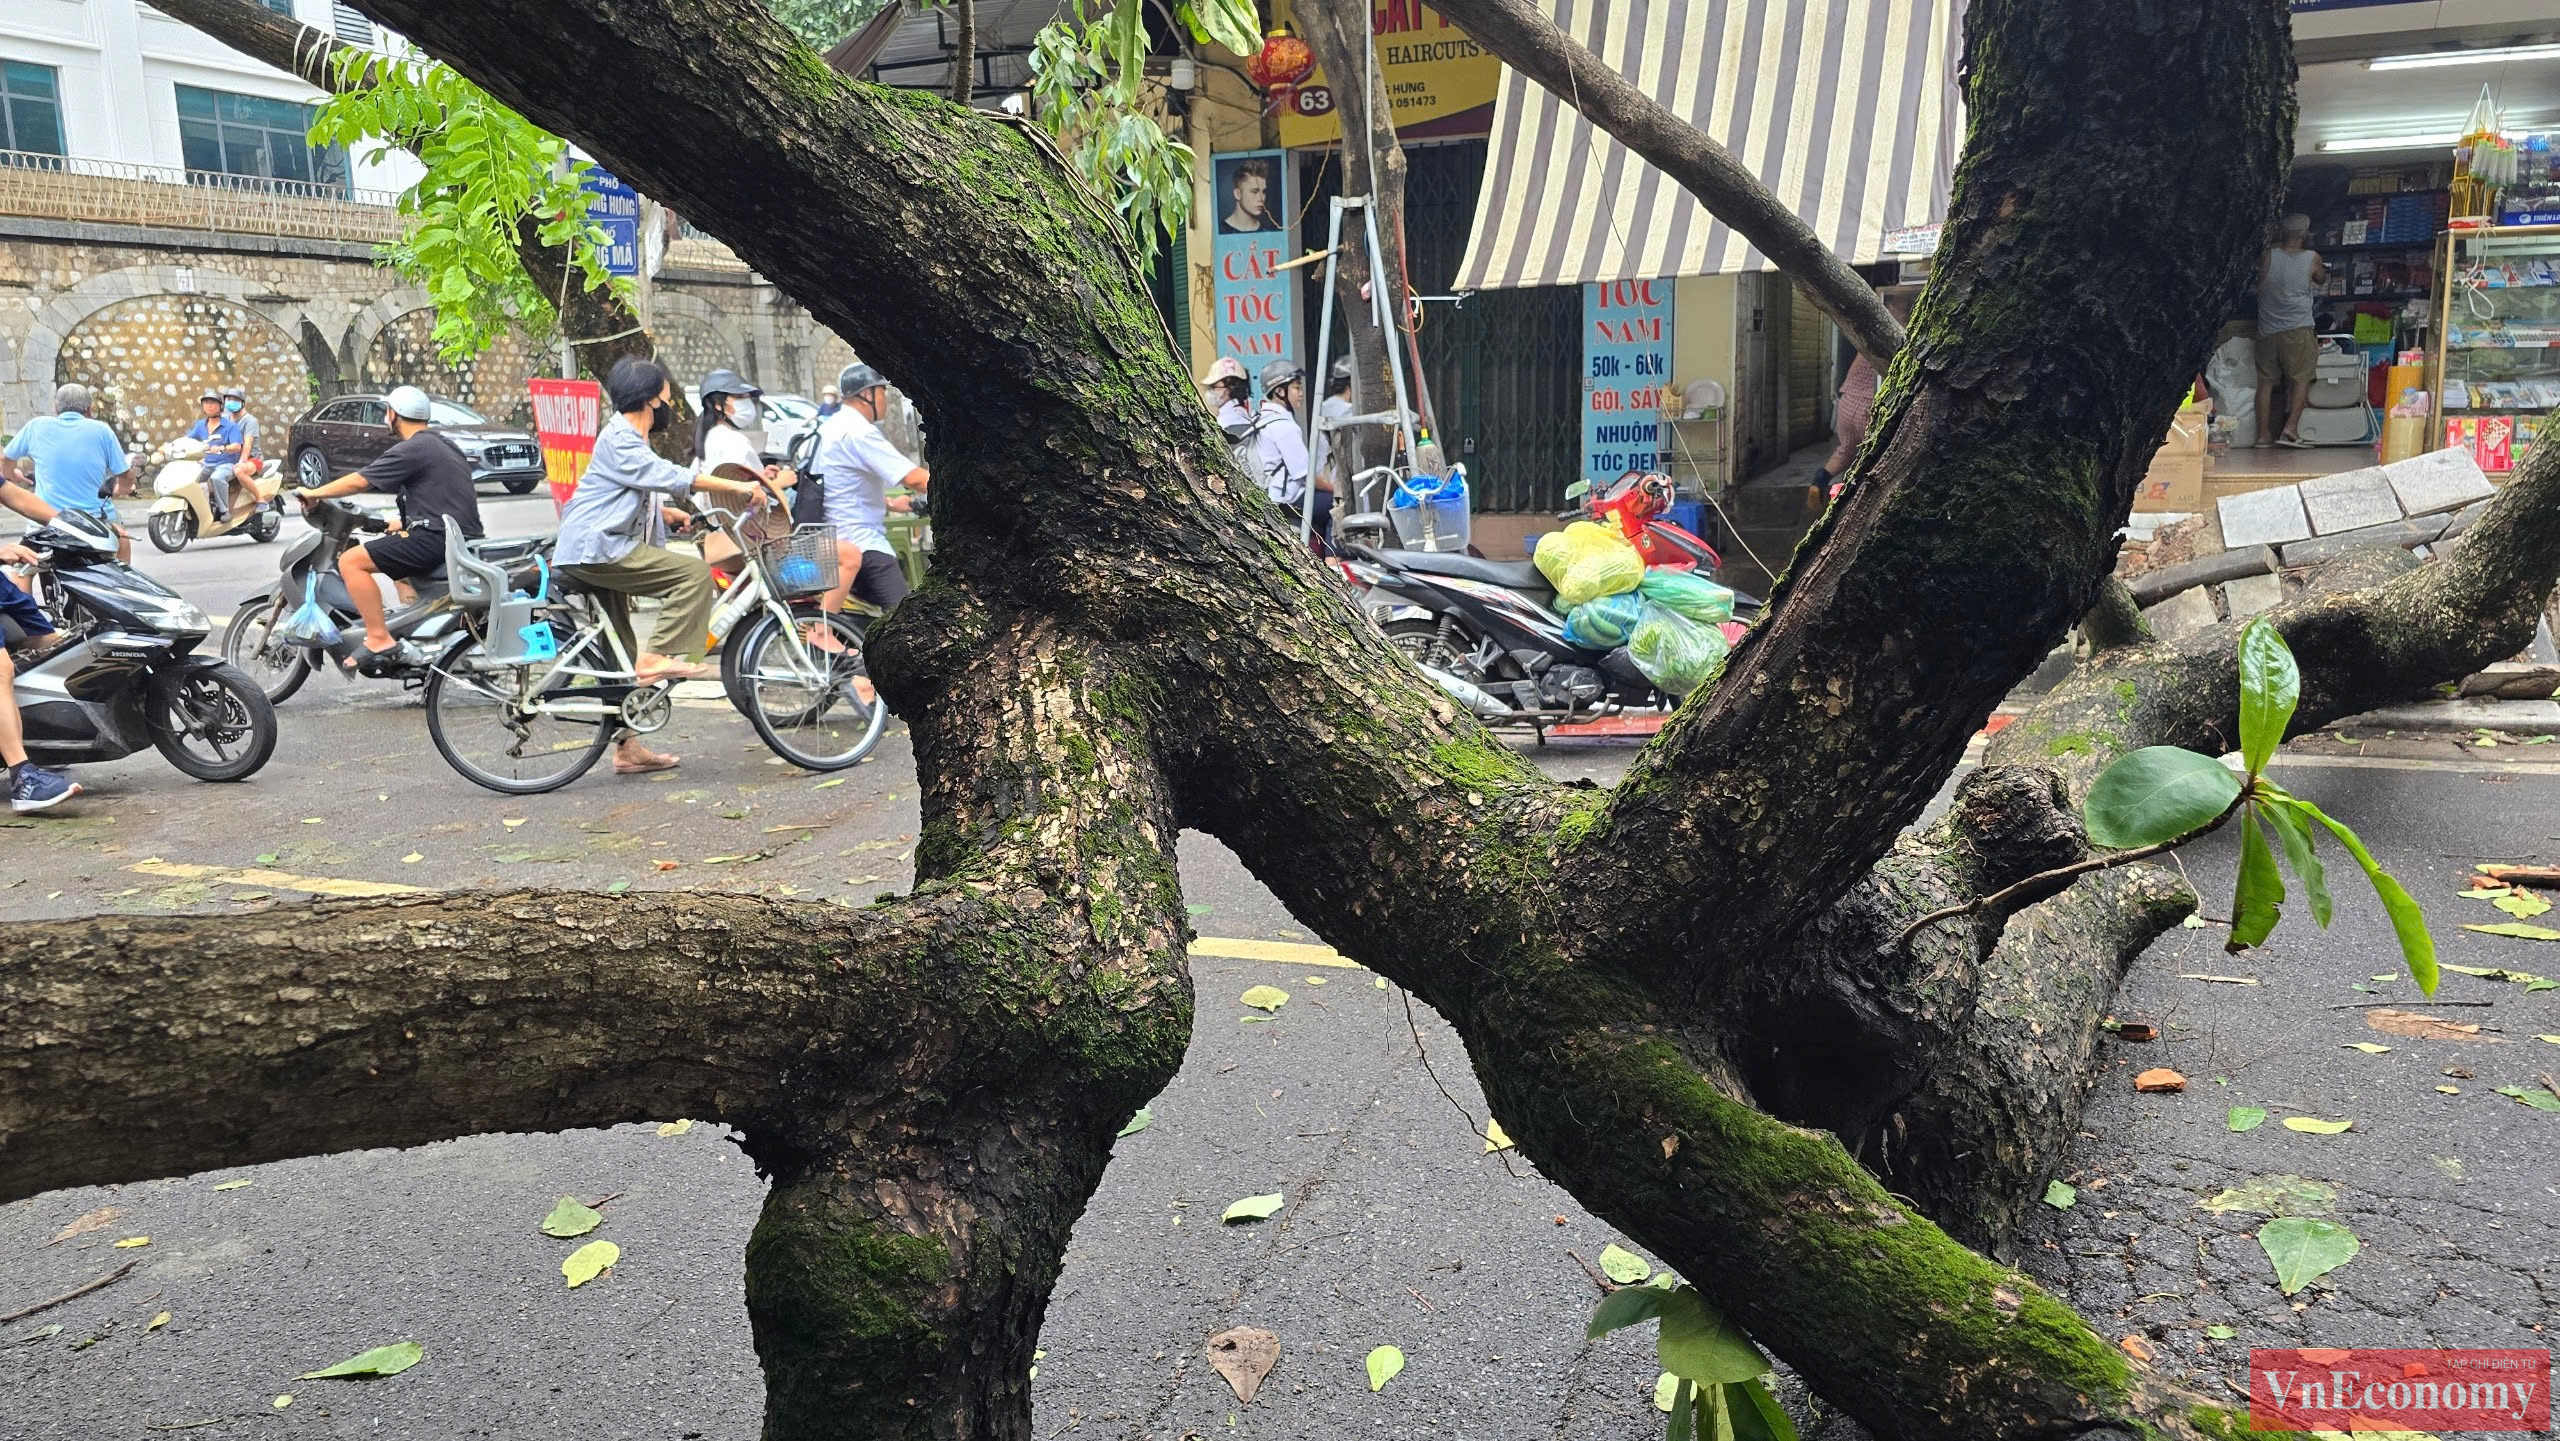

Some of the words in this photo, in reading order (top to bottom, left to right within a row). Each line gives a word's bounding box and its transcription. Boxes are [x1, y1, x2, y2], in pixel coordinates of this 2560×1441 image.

[1387, 40, 1479, 65] HAIRCUTS
[1300, 90, 1329, 110] 63
[1396, 96, 1436, 108] 051473
[613, 242, 633, 266] MÃ
[1223, 240, 1280, 281] CẮT
[1224, 288, 1282, 323] TÓC
[1594, 318, 1663, 343] NAM
[1227, 333, 1283, 355] NAM
[1592, 355, 1620, 377] 50k
[1636, 353, 1663, 376] 60k
[1596, 422, 1658, 446] NHUỘM
[1592, 450, 1622, 471] TÓC
